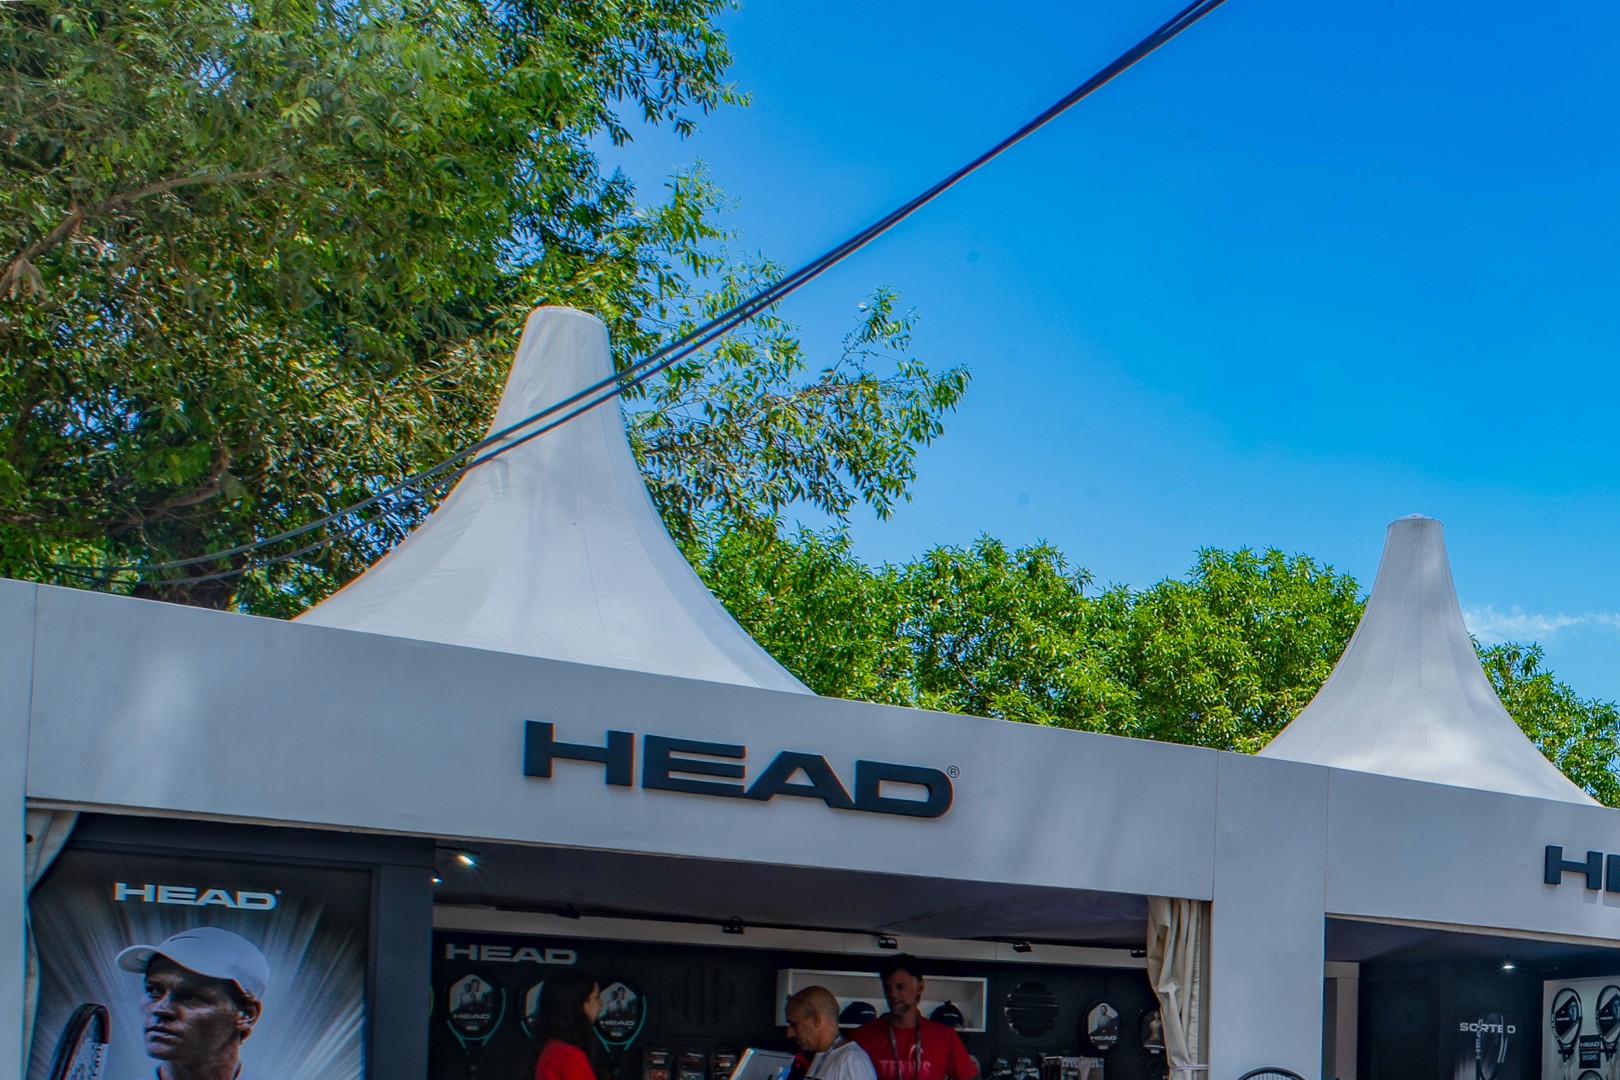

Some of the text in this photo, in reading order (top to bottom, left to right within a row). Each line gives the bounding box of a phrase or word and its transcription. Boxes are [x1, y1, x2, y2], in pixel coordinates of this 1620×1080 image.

[523, 719, 954, 818] HEAD
[114, 882, 277, 911] HEAD
[446, 943, 578, 965] HEAD
